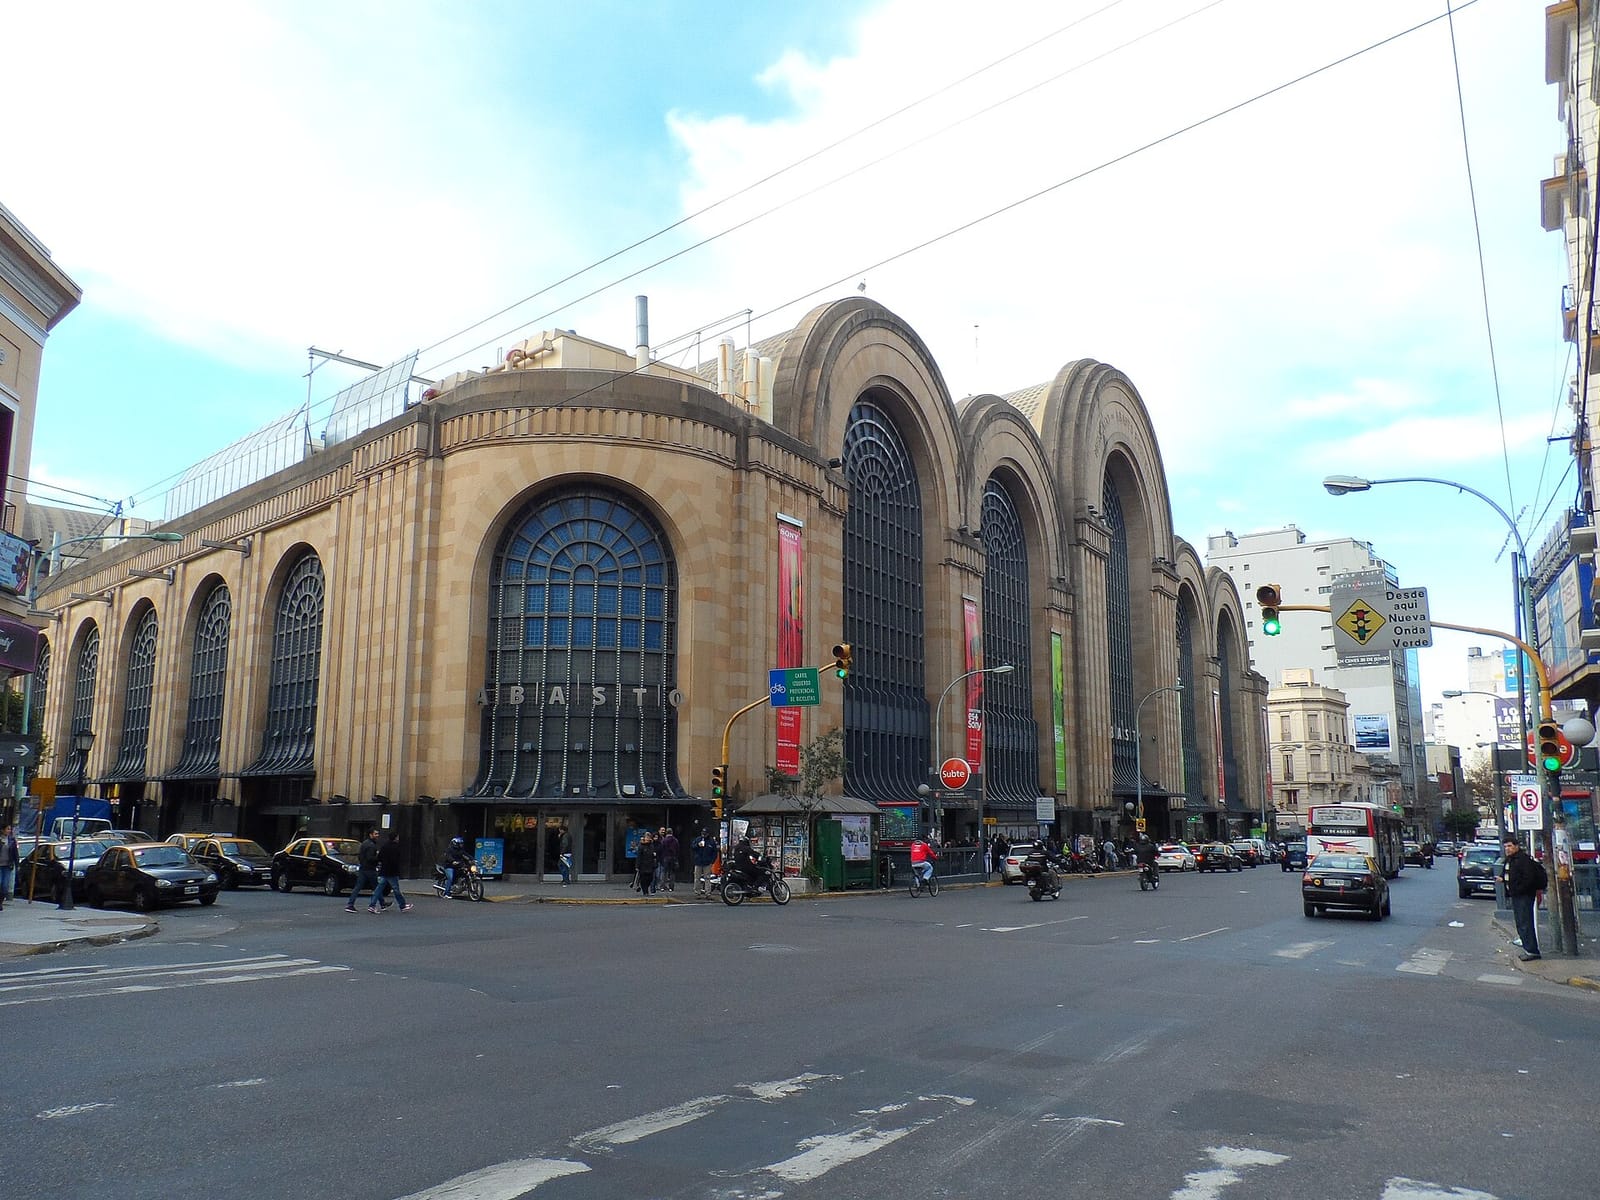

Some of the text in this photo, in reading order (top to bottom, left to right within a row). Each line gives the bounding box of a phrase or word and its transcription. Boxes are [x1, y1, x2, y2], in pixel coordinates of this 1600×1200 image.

[780, 528, 799, 541] SONY
[1386, 591, 1425, 600] Desde
[1389, 614, 1426, 623] Nueva
[1394, 625, 1426, 635] Onda
[1393, 639, 1429, 647] Verde
[477, 686, 684, 708] ABASTO
[942, 770, 965, 779] Subte
